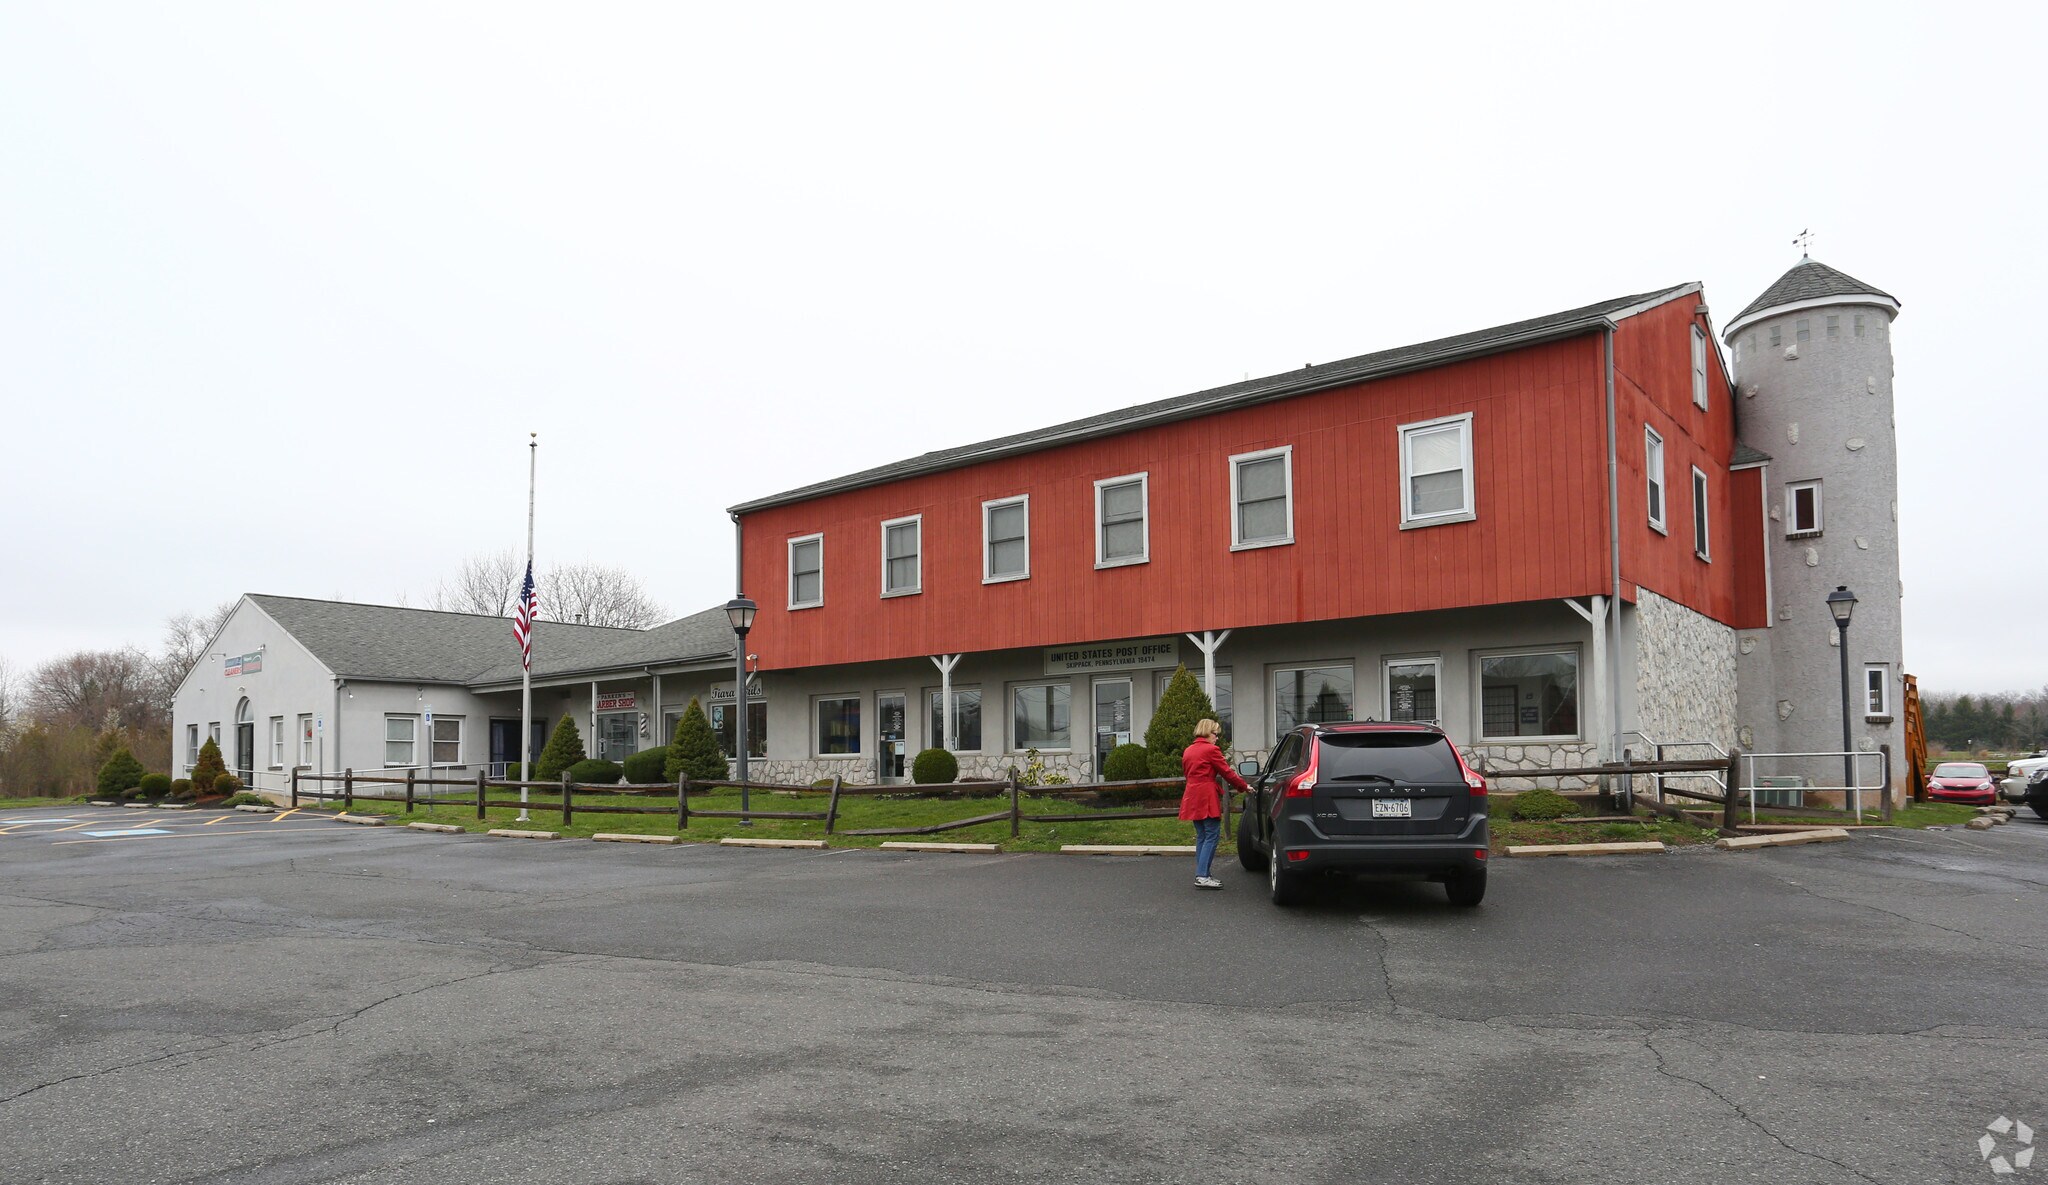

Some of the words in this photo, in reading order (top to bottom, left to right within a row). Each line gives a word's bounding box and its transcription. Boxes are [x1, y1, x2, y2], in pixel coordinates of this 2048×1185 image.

[1051, 651, 1079, 662] UNITED
[1082, 648, 1112, 660] STATES
[1116, 647, 1138, 657] POST
[1142, 644, 1171, 655] OFFICE
[1066, 661, 1094, 669] SKIPPACK,
[1095, 657, 1136, 666] PENNSYLVANIA
[711, 687, 735, 699] Tiara
[618, 697, 635, 707] SHOP
